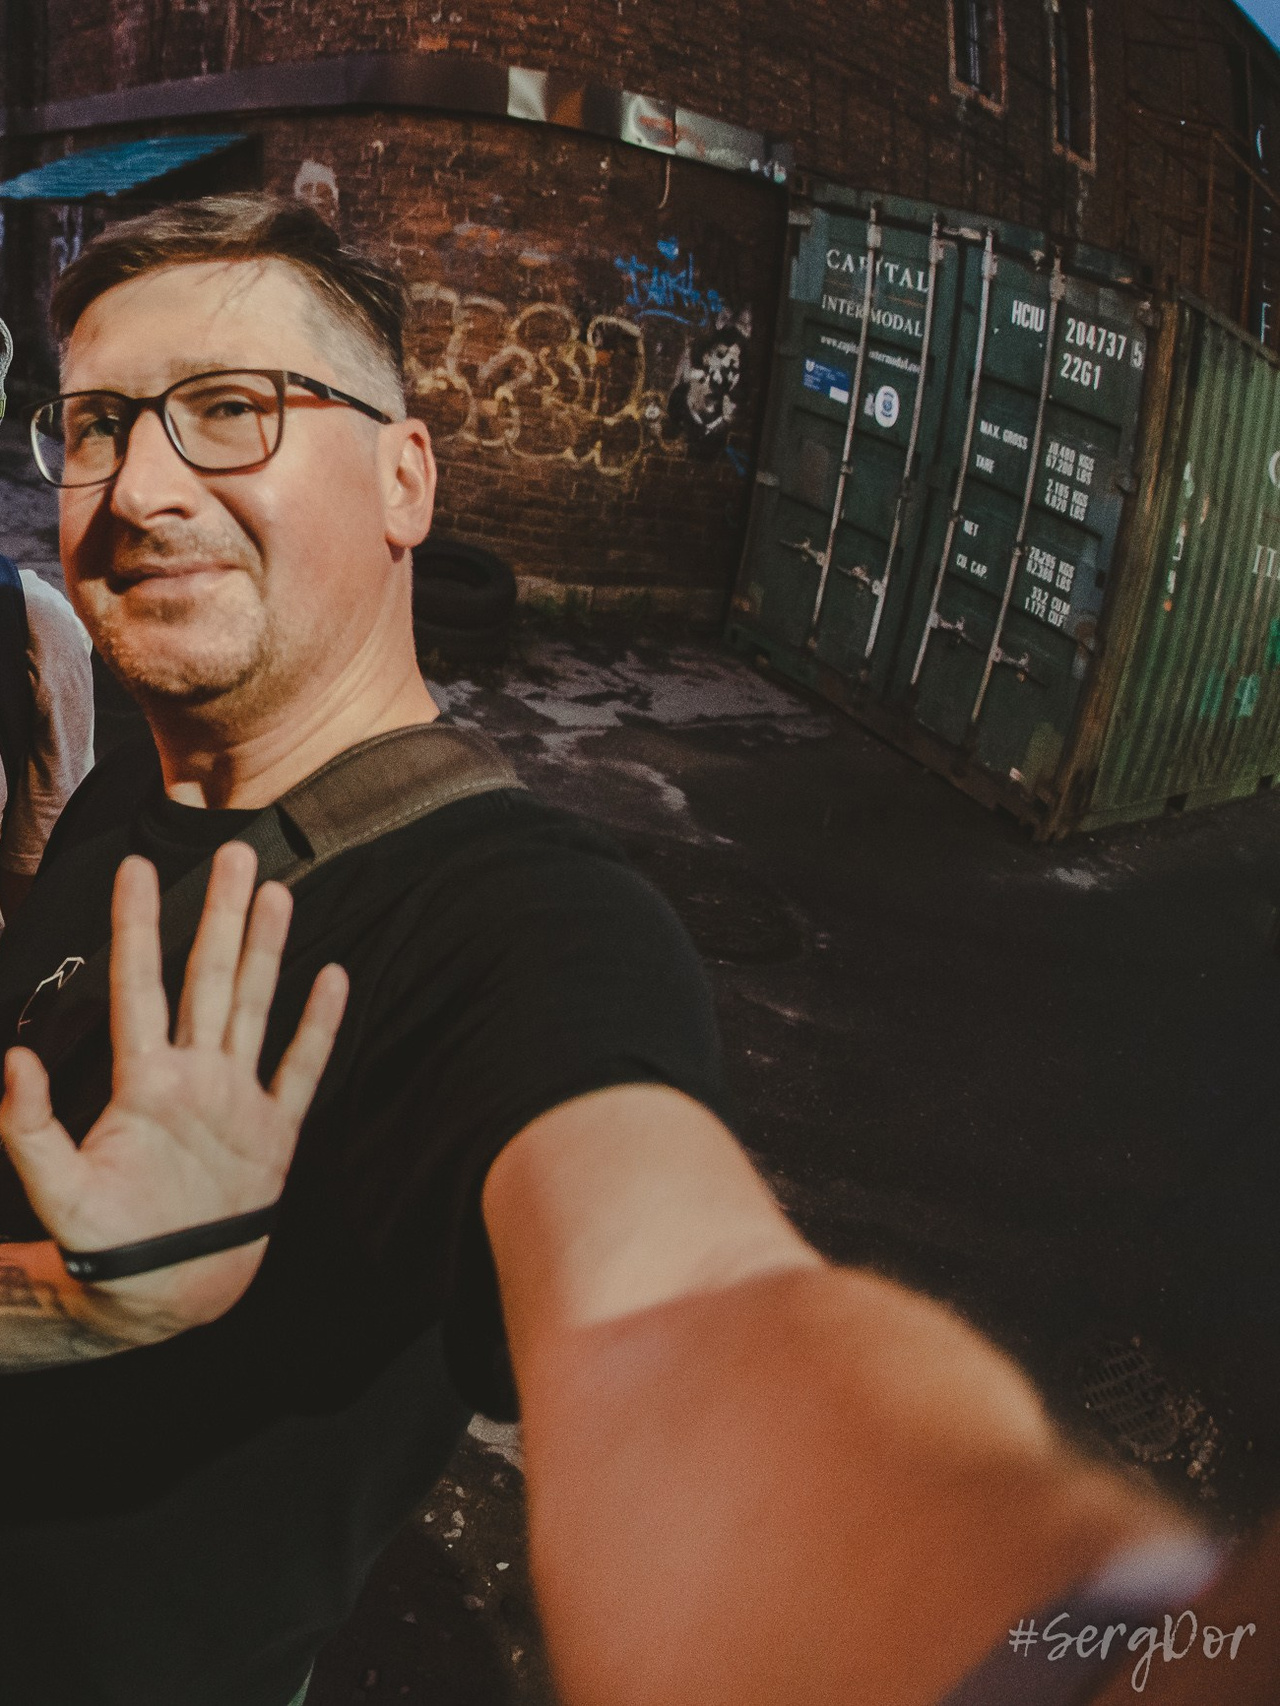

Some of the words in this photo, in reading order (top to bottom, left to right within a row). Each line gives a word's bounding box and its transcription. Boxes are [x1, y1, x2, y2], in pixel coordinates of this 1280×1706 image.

[826, 248, 929, 293] CAPITAL
[1011, 299, 1045, 332] HCIU
[1065, 317, 1127, 361] 204737
[1133, 340, 1145, 368] 5
